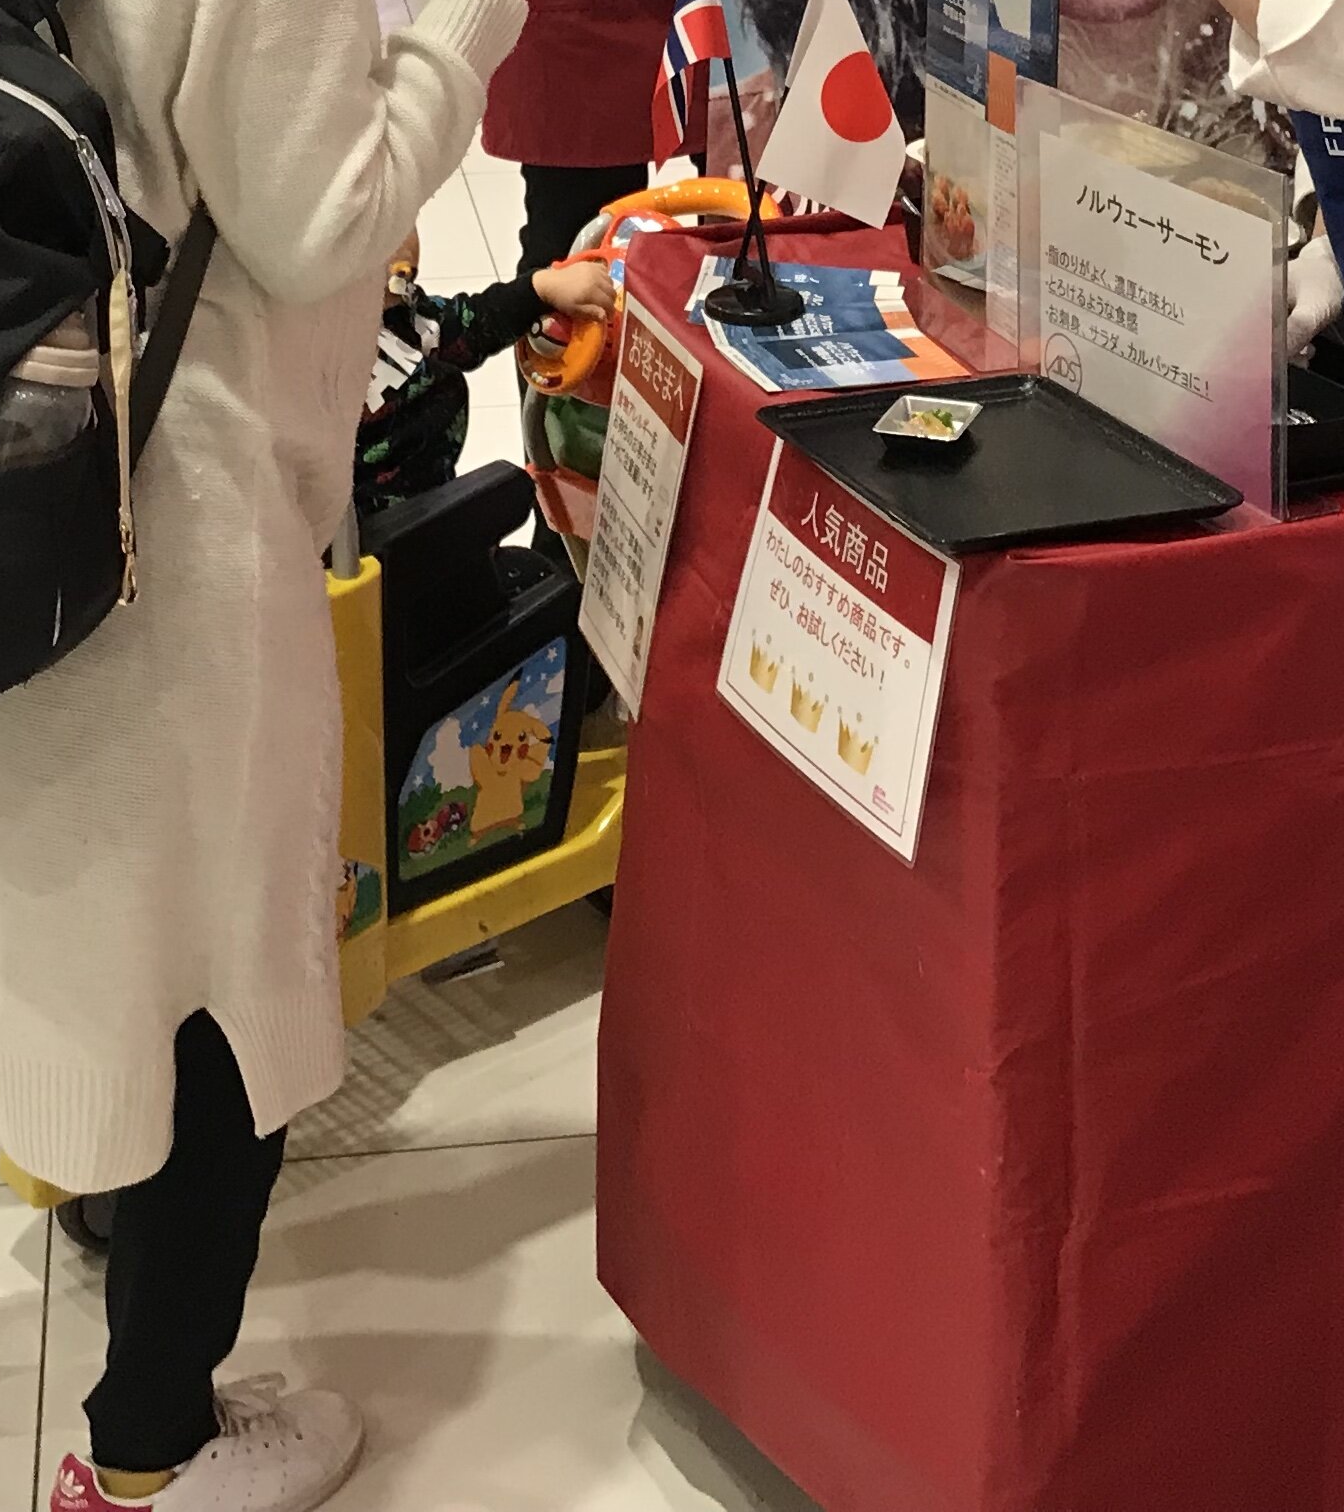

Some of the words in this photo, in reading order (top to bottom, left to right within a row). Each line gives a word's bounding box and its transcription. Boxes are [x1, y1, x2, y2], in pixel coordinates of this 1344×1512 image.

[1075, 184, 1230, 265] ノルウェーサーモン
[627, 327, 685, 412] お客さまへ
[800, 491, 889, 595] 人気商品
[765, 526, 912, 670] わたしのおすすめ商品です。
